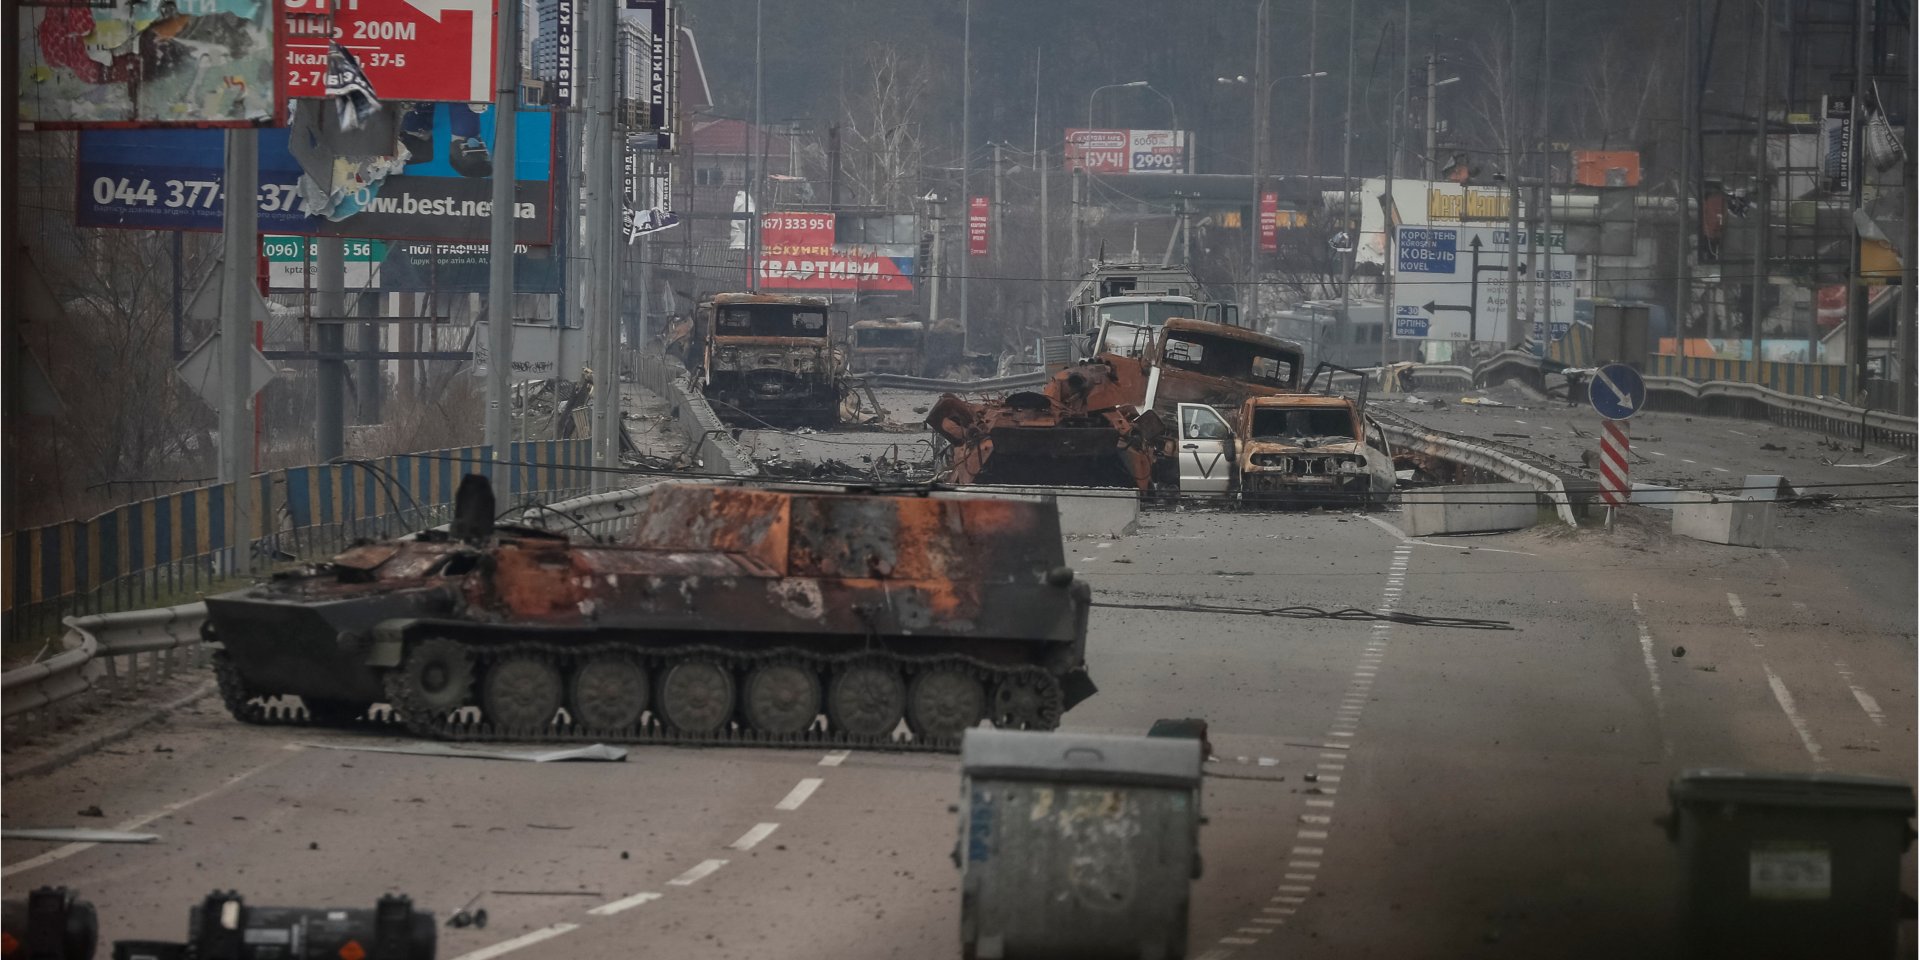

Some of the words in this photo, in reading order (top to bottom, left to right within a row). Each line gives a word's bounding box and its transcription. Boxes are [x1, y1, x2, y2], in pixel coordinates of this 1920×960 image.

[353, 21, 416, 40] 200М
[370, 53, 406, 67] 37-Б
[652, 34, 663, 105] ПАРКІНГ
[1134, 137, 1158, 146] 6000
[1537, 142, 1570, 151] CTY
[1085, 152, 1123, 167] БУЧІ
[1841, 119, 1850, 187] БІЗНЕС-КЛАС
[1136, 154, 1173, 168] 2990
[93, 177, 157, 206] 044
[785, 219, 807, 230] 333
[810, 219, 824, 230] 95
[1494, 232, 1525, 243] М-7
[409, 244, 489, 255] ПОЛГРАФІЧНІ
[1401, 248, 1455, 261] КОВЕЛЬ
[759, 261, 879, 280] КВАРТИРИ
[1400, 262, 1429, 271] KOVEL
[1397, 306, 1418, 314] Р-30
[1397, 320, 1427, 328] ІРПІНЬ
[1193, 450, 1222, 479] V
